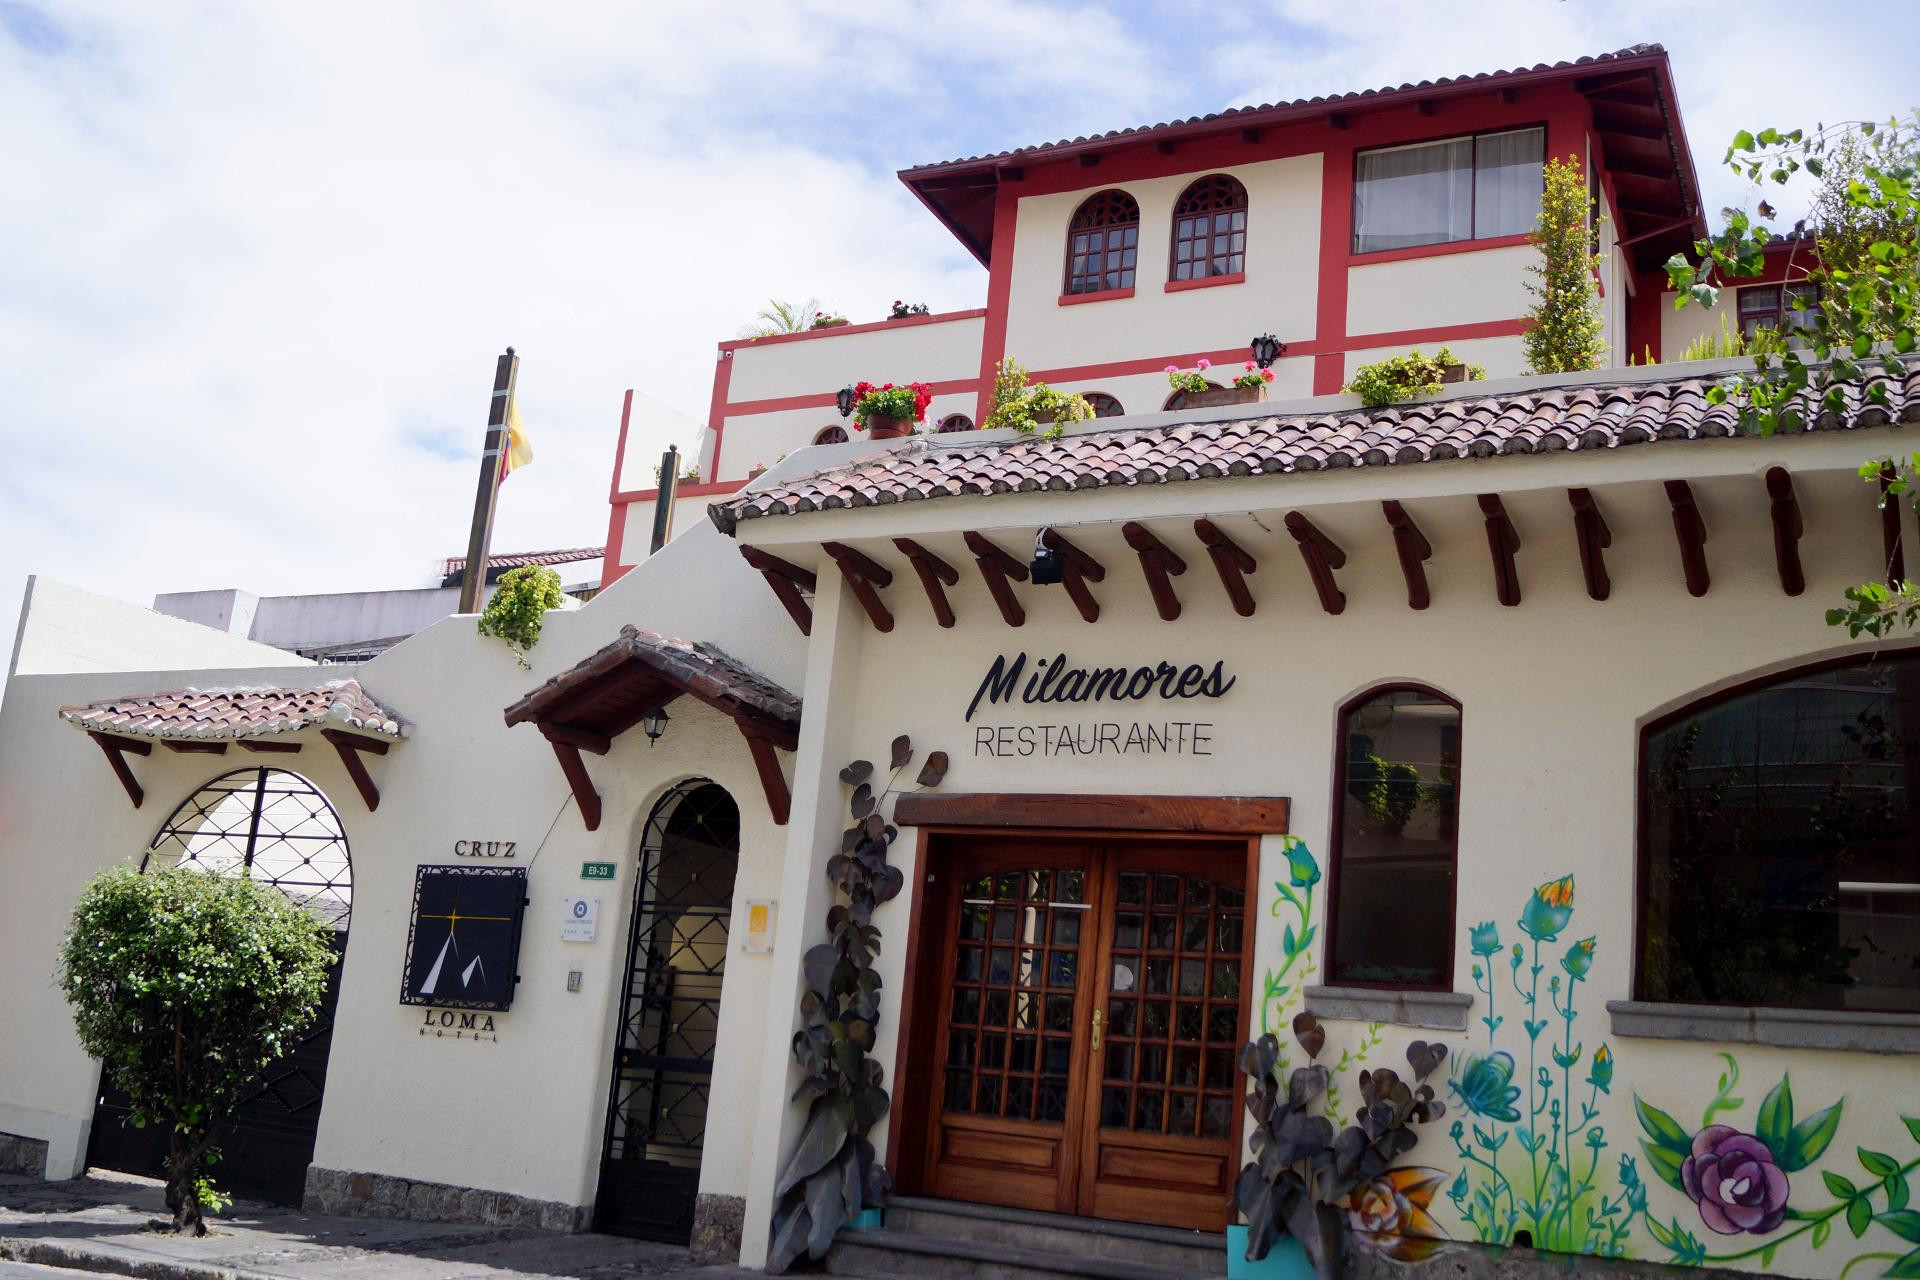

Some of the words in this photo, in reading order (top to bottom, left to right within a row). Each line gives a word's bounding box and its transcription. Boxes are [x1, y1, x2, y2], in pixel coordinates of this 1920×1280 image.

[965, 652, 1236, 723] Milamores
[975, 722, 1213, 757] RESTAURANTE
[454, 840, 516, 858] CRUZ
[424, 1009, 495, 1031] LOMA
[420, 1027, 497, 1042] HOTEL
